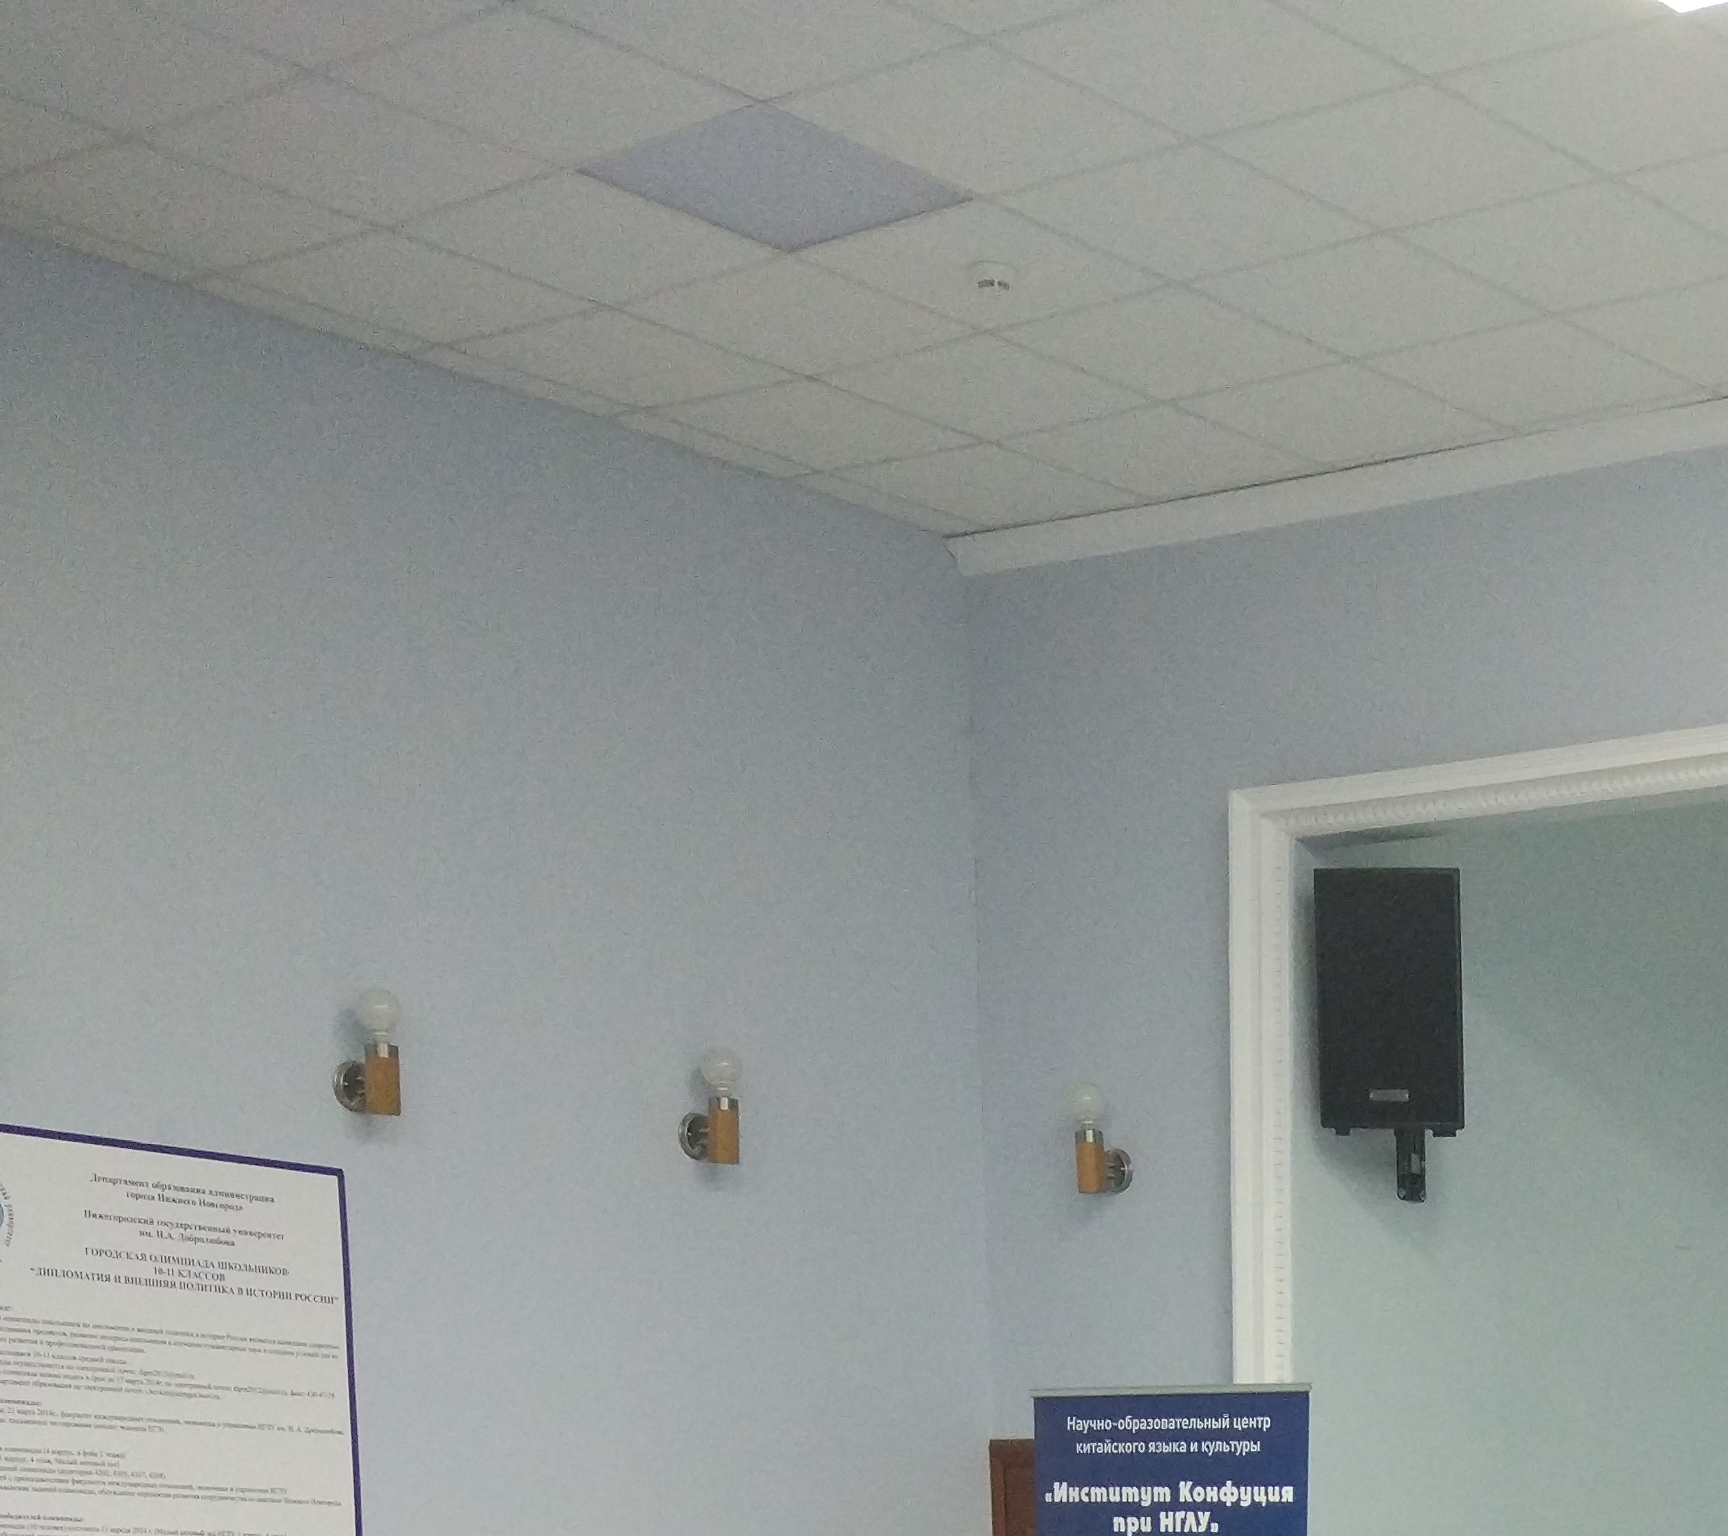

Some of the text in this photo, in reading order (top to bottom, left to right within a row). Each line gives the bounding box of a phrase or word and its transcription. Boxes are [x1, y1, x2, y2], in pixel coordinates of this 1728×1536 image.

[84, 1247, 147, 1262] ГОРОДСКАЯ
[149, 1253, 215, 1269] ОЛИМПИАДА
[124, 1275, 177, 1289] ВНЕШНЯЯ
[179, 1280, 235, 1295] ПОЛИТИКА
[237, 1286, 244, 1295] В
[178, 1269, 226, 1282] КЛАССОВ
[1066, 1414, 1271, 1433] Научно-образовательный центр
[1076, 1438, 1261, 1456] китайского языка и культуры
[1179, 1480, 1294, 1507] Конфуция
[1113, 1514, 1152, 1536] при
